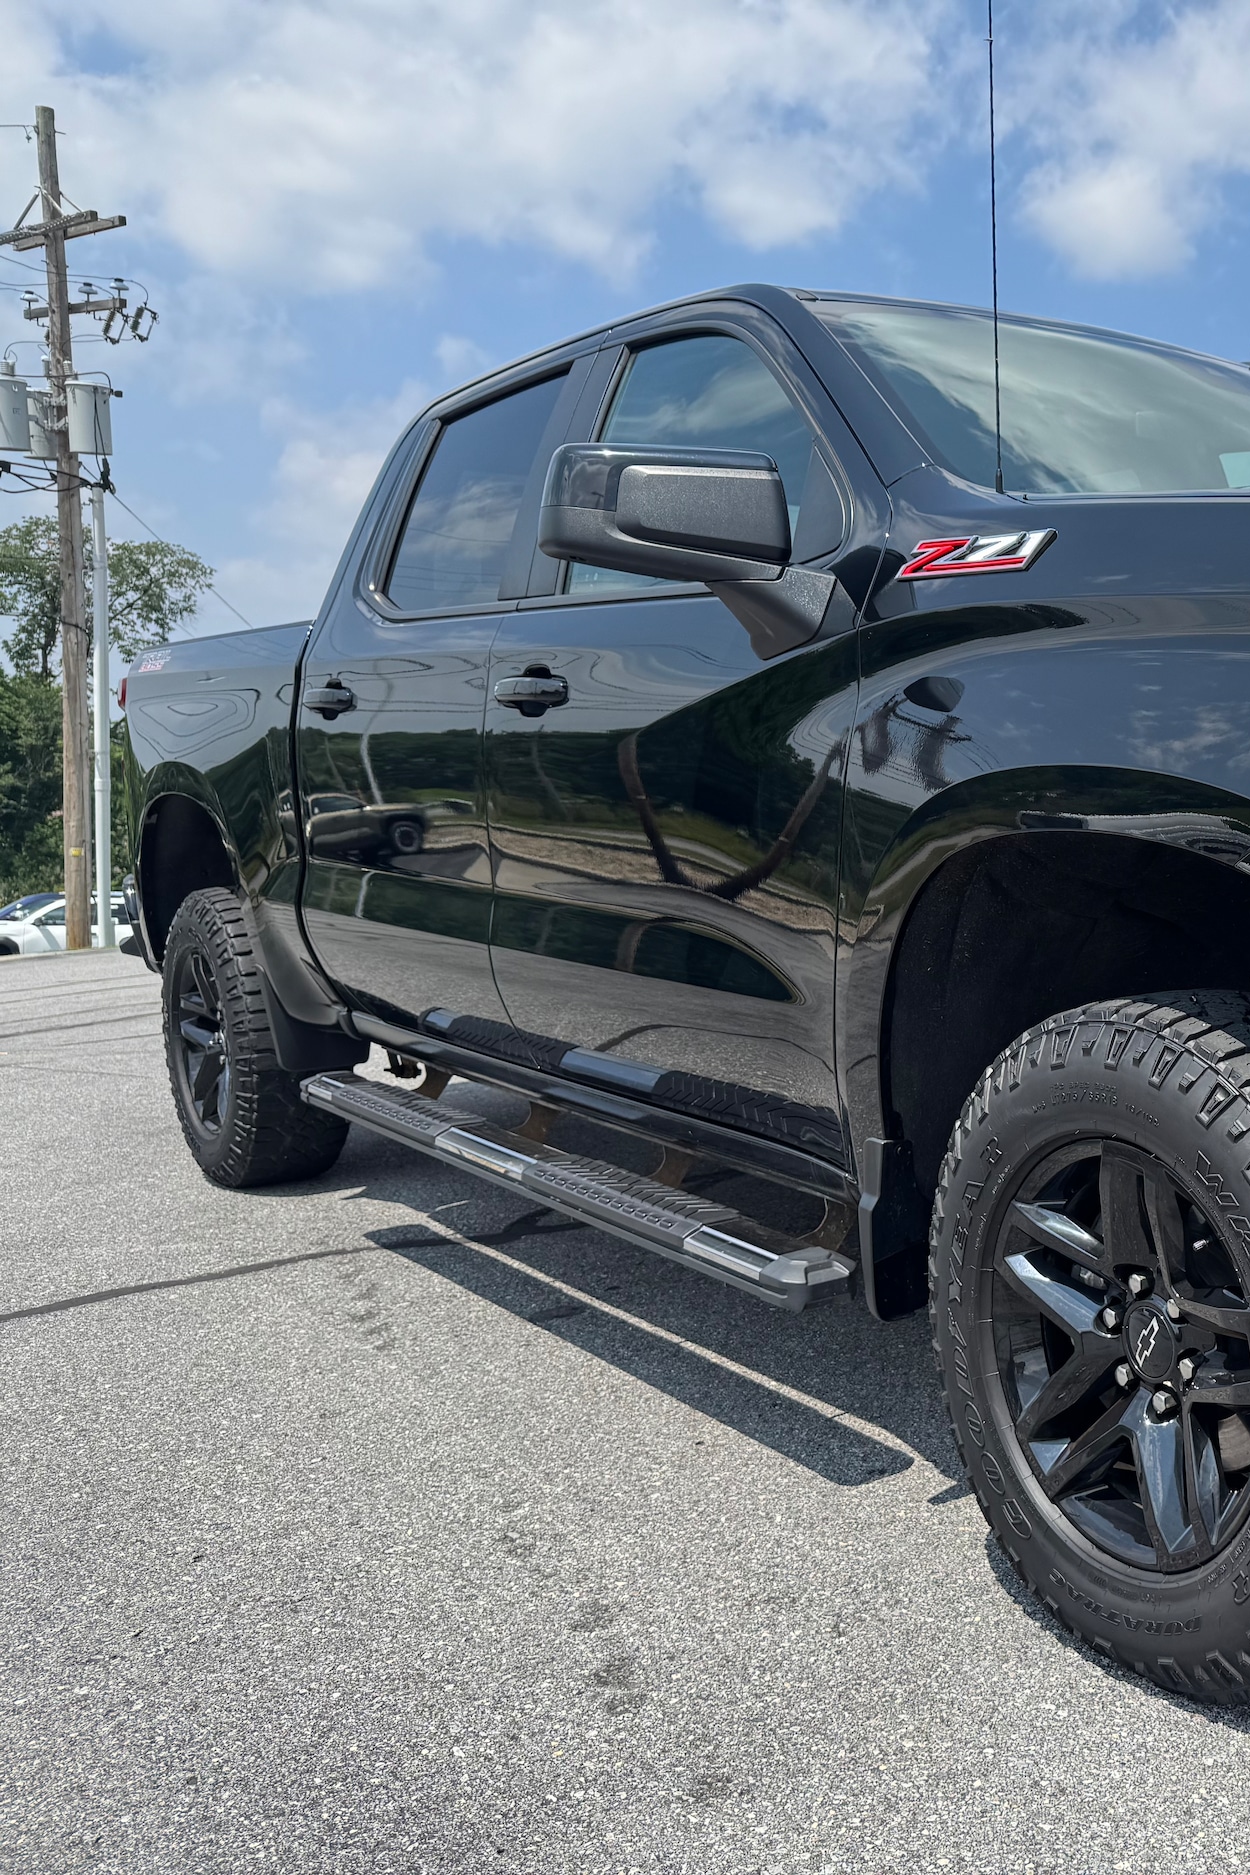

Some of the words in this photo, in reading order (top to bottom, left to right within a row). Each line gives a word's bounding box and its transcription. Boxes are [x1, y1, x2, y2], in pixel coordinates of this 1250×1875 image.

[894, 527, 1059, 582] Z71
[948, 1136, 1033, 1539] GOODYEAR
[1049, 1567, 1203, 1636] DURATRAC
